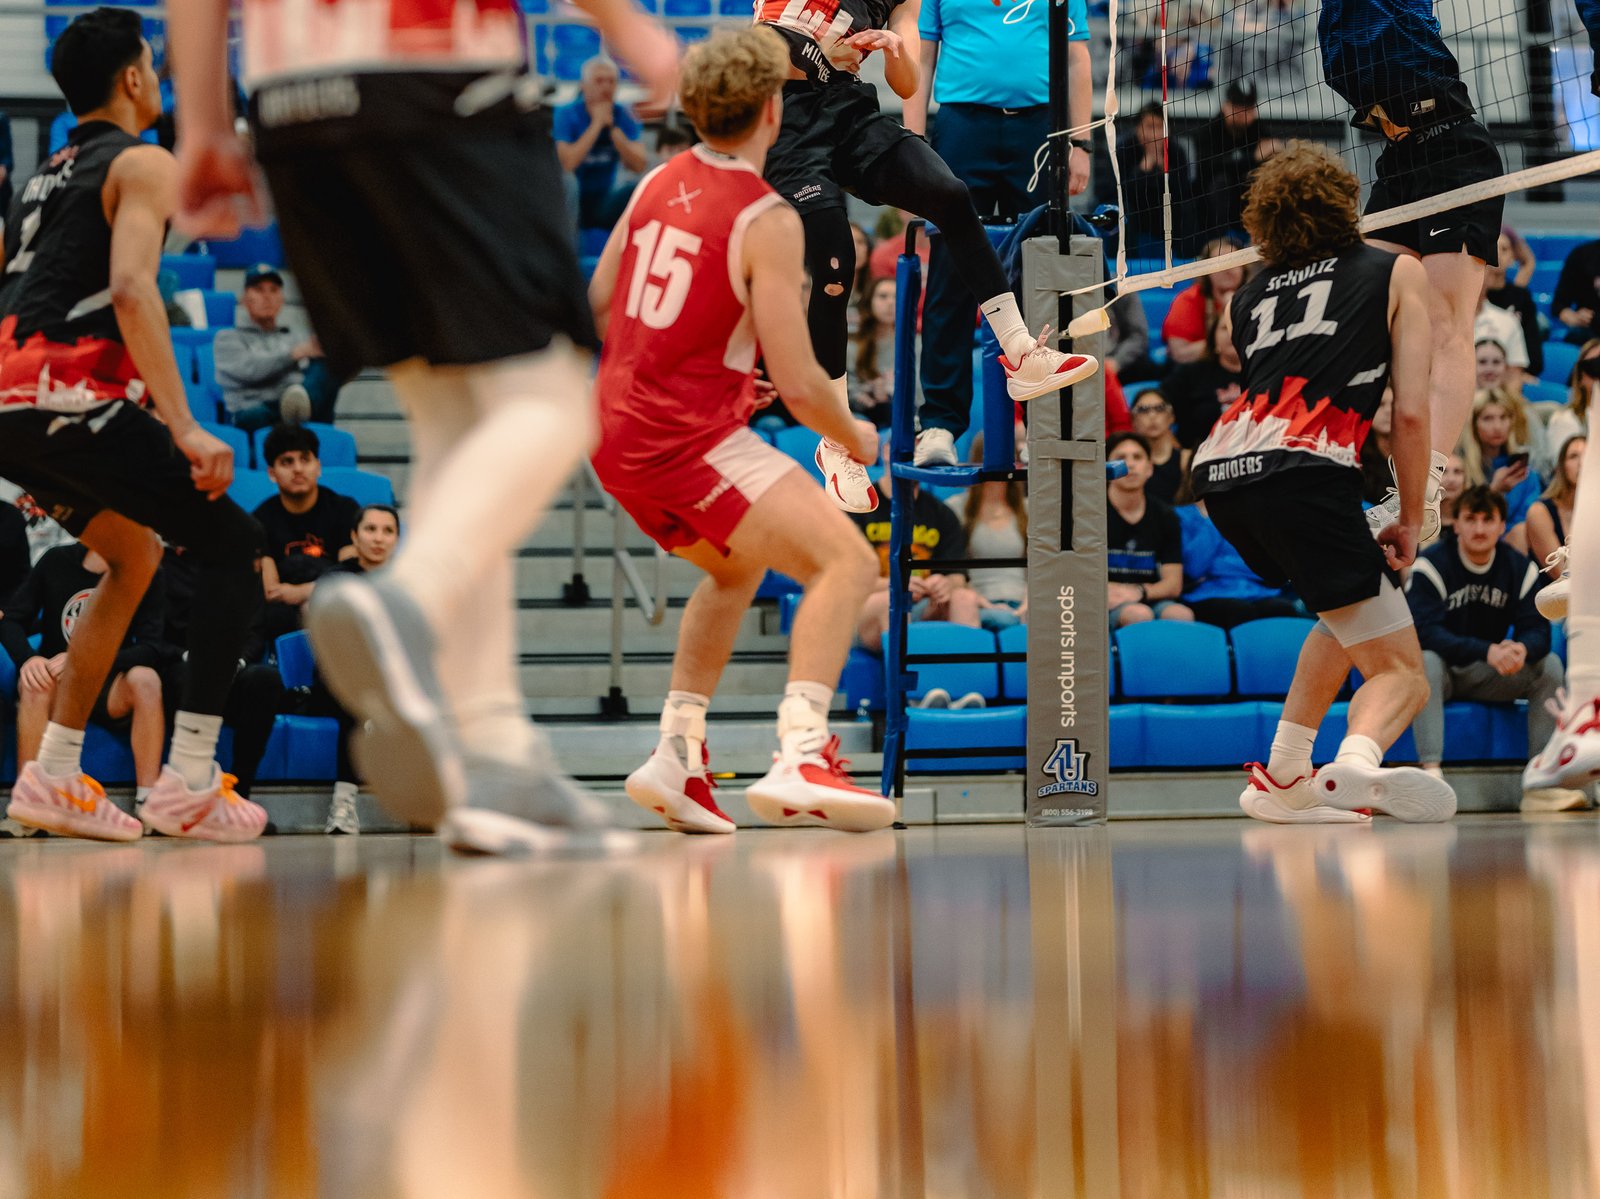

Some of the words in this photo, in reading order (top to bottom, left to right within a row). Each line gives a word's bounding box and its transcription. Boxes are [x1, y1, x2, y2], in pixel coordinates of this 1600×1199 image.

[624, 219, 703, 330] 15
[1245, 279, 1339, 360] 11
[1208, 455, 1264, 482] RAIDERS
[1057, 585, 1077, 648] sports
[1038, 781, 1098, 797] SPARTANS
